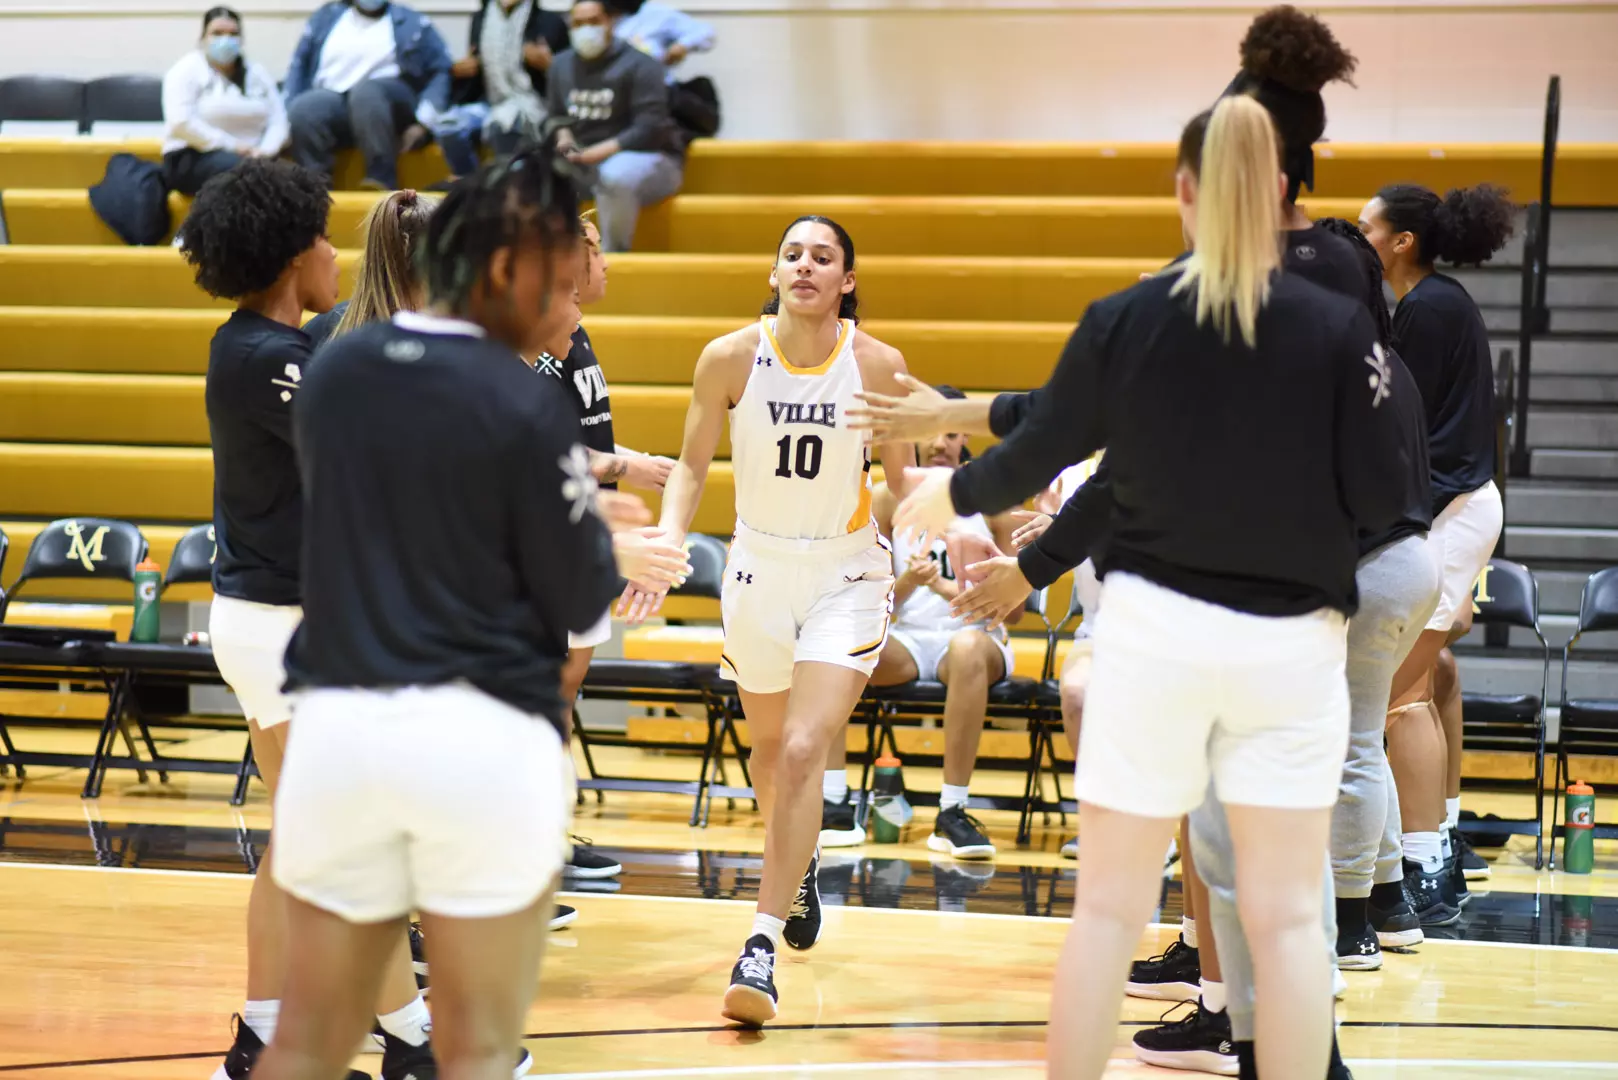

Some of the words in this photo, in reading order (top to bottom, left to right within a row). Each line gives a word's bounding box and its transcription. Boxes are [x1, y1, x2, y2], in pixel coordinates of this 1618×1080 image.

[766, 400, 836, 428] VILLE
[775, 434, 823, 480] 10
[139, 581, 157, 600] G
[1572, 806, 1590, 825] G
